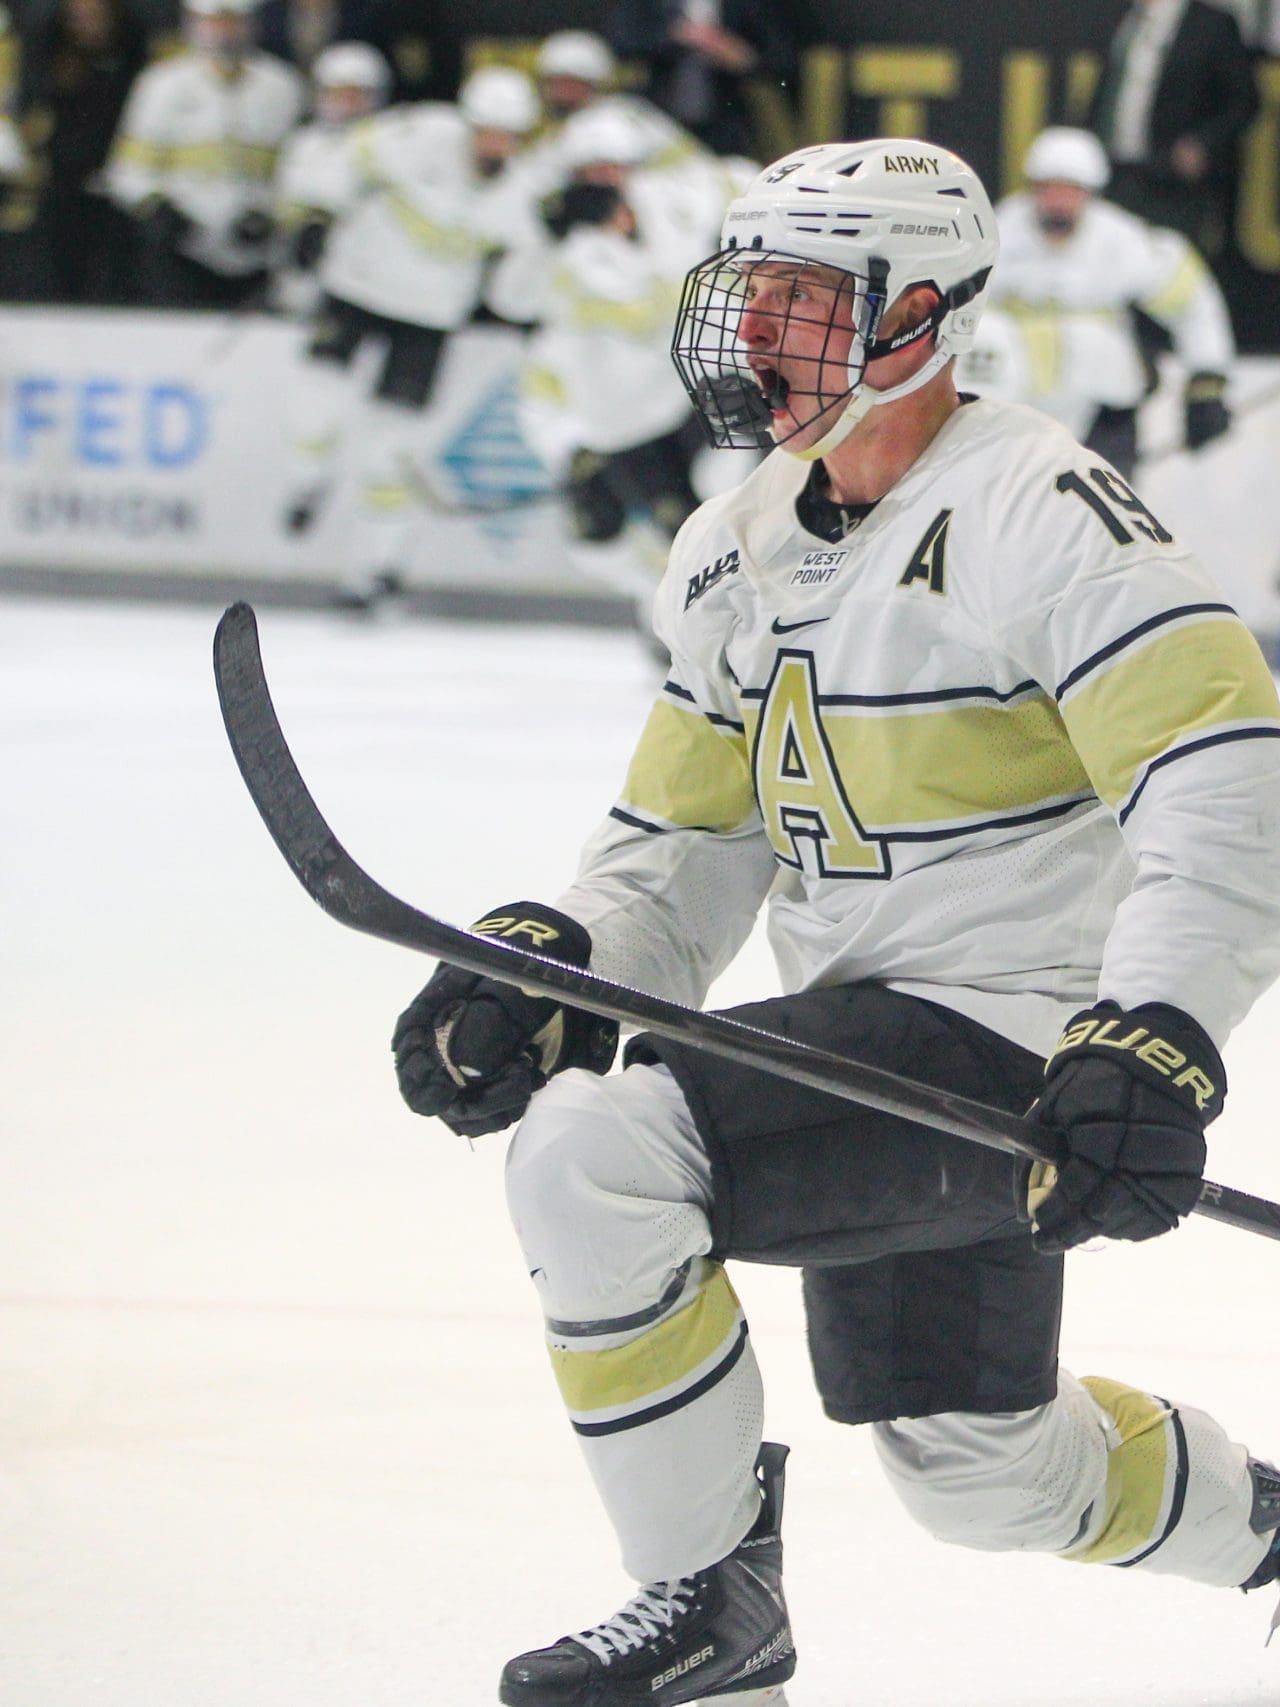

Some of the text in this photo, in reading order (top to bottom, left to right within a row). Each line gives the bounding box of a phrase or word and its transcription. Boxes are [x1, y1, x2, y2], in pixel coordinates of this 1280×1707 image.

[884, 155, 940, 176] ARMY
[889, 223, 950, 238] BAUER
[890, 317, 933, 350] BAUER
[1055, 467, 1175, 547] 19
[803, 551, 848, 567] WEST
[896, 507, 957, 596] A
[790, 568, 838, 586] POINT
[753, 647, 893, 881] A
[651, 1644, 716, 1692] BAUER
